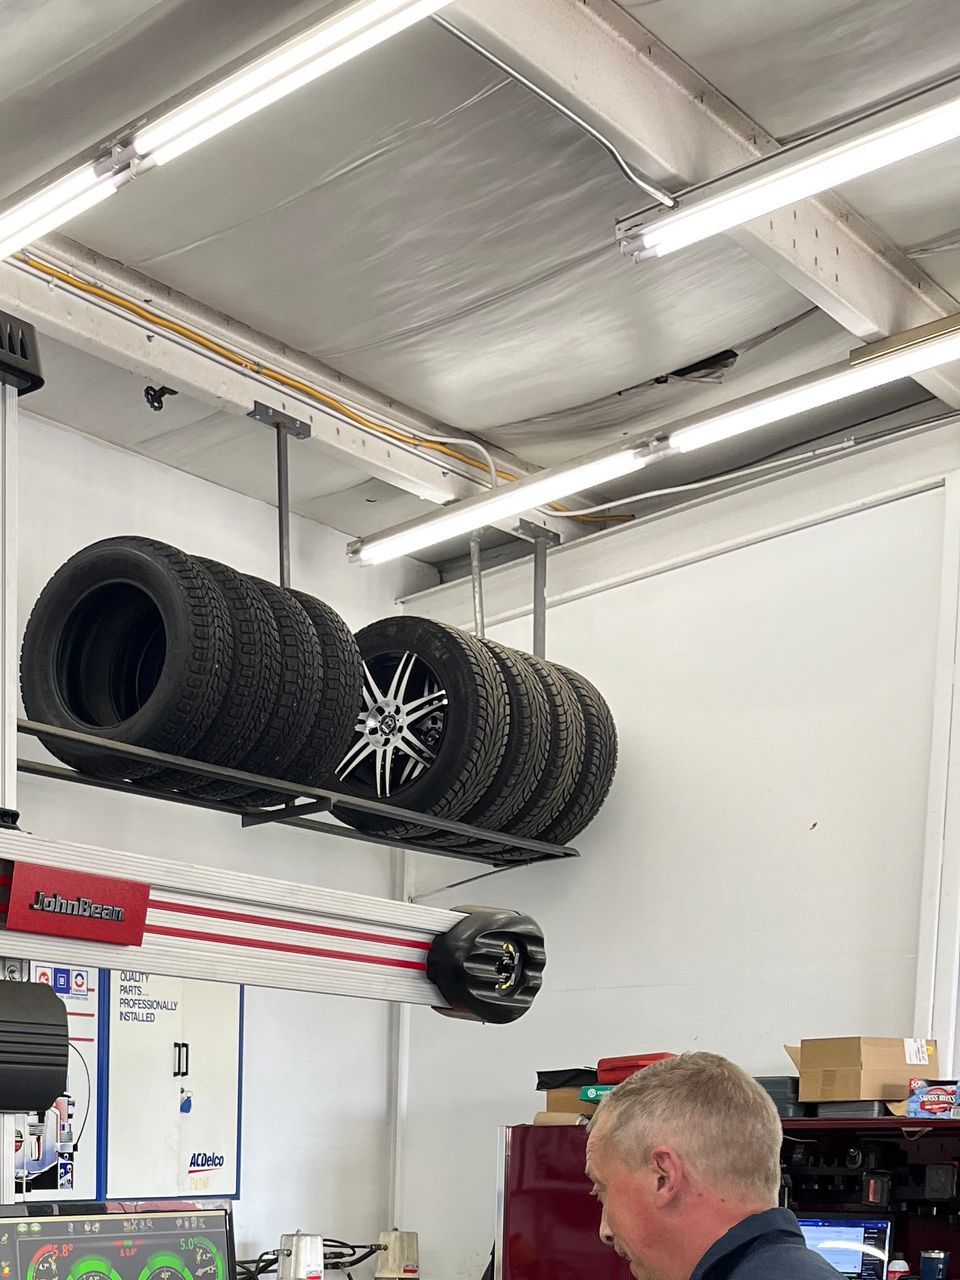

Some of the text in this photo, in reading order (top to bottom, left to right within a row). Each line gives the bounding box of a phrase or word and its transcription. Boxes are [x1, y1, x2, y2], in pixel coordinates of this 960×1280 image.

[31, 891, 125, 921] JohnBean
[120, 970, 150, 983] QUALITY
[120, 998, 178, 1011] PROFESSIONALLY
[120, 1011, 155, 1023] INSTALLED
[189, 1152, 225, 1168] ACDelco
